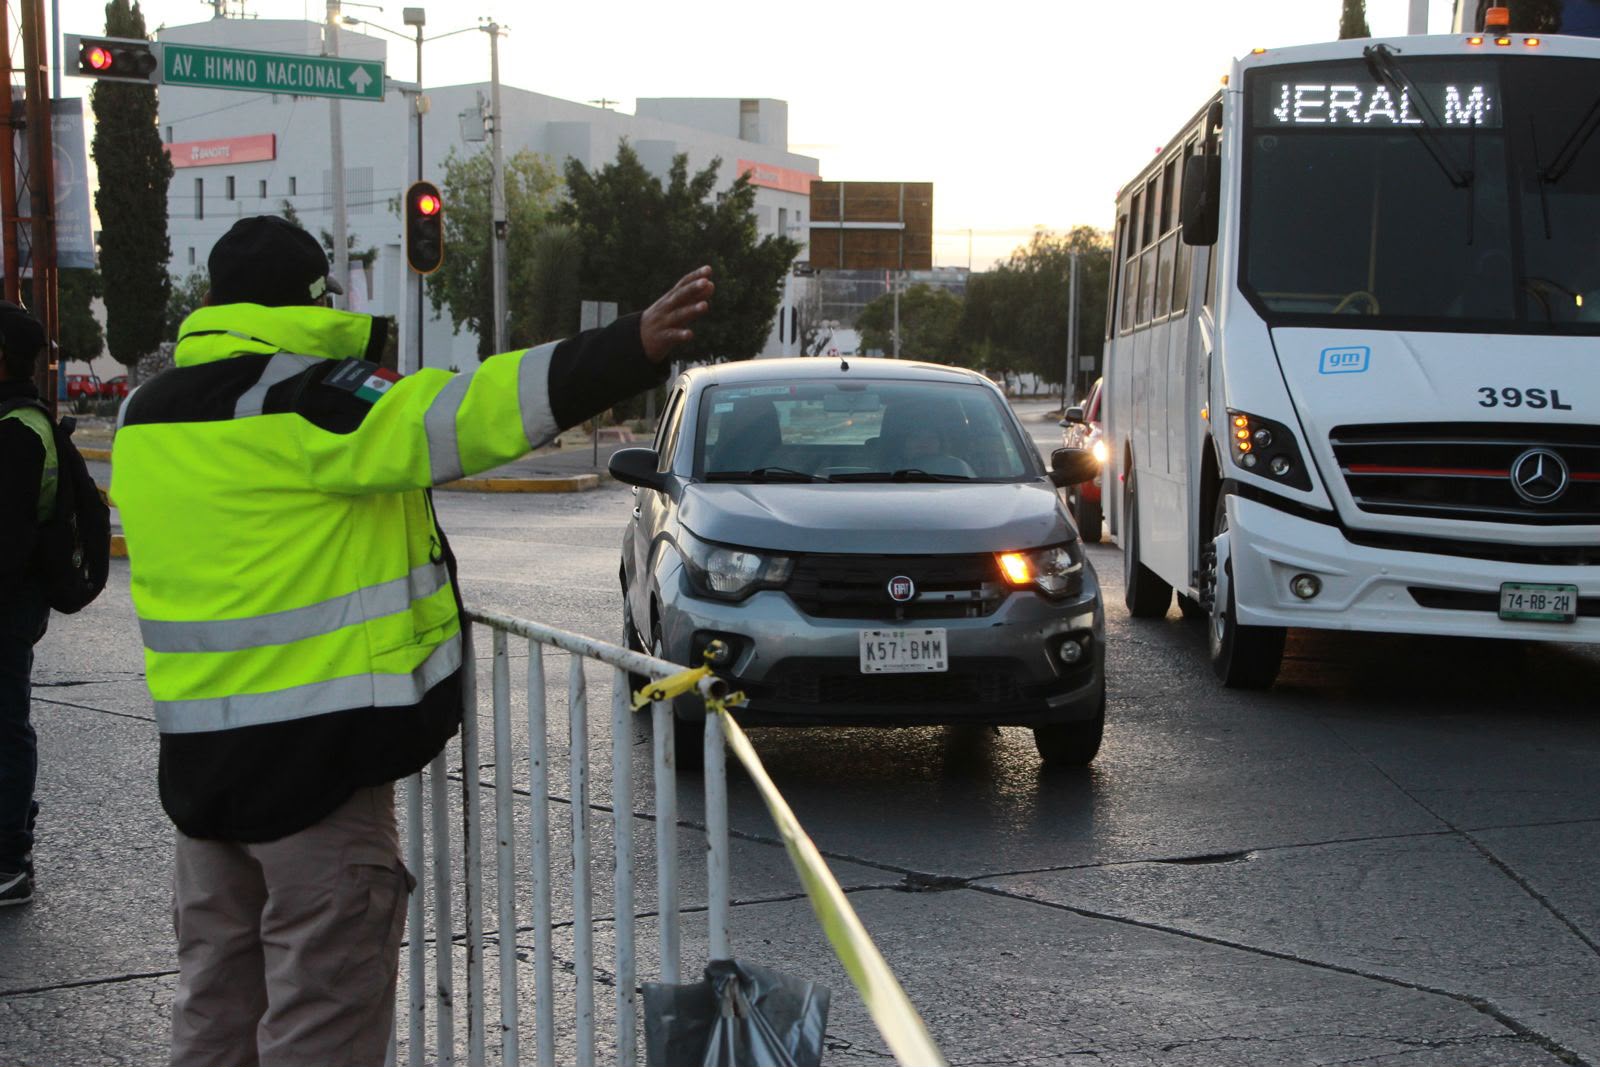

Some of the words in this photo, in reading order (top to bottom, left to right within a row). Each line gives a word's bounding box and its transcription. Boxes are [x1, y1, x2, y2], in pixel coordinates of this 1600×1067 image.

[172, 53, 197, 78] AV.
[205, 56, 257, 82] HIMNO
[266, 61, 345, 89] NACIONAL
[1329, 352, 1360, 366] gm
[1478, 387, 1572, 411] 39SL
[1508, 593, 1570, 611] 74-RB-2H
[866, 640, 942, 661] K57-BMM
